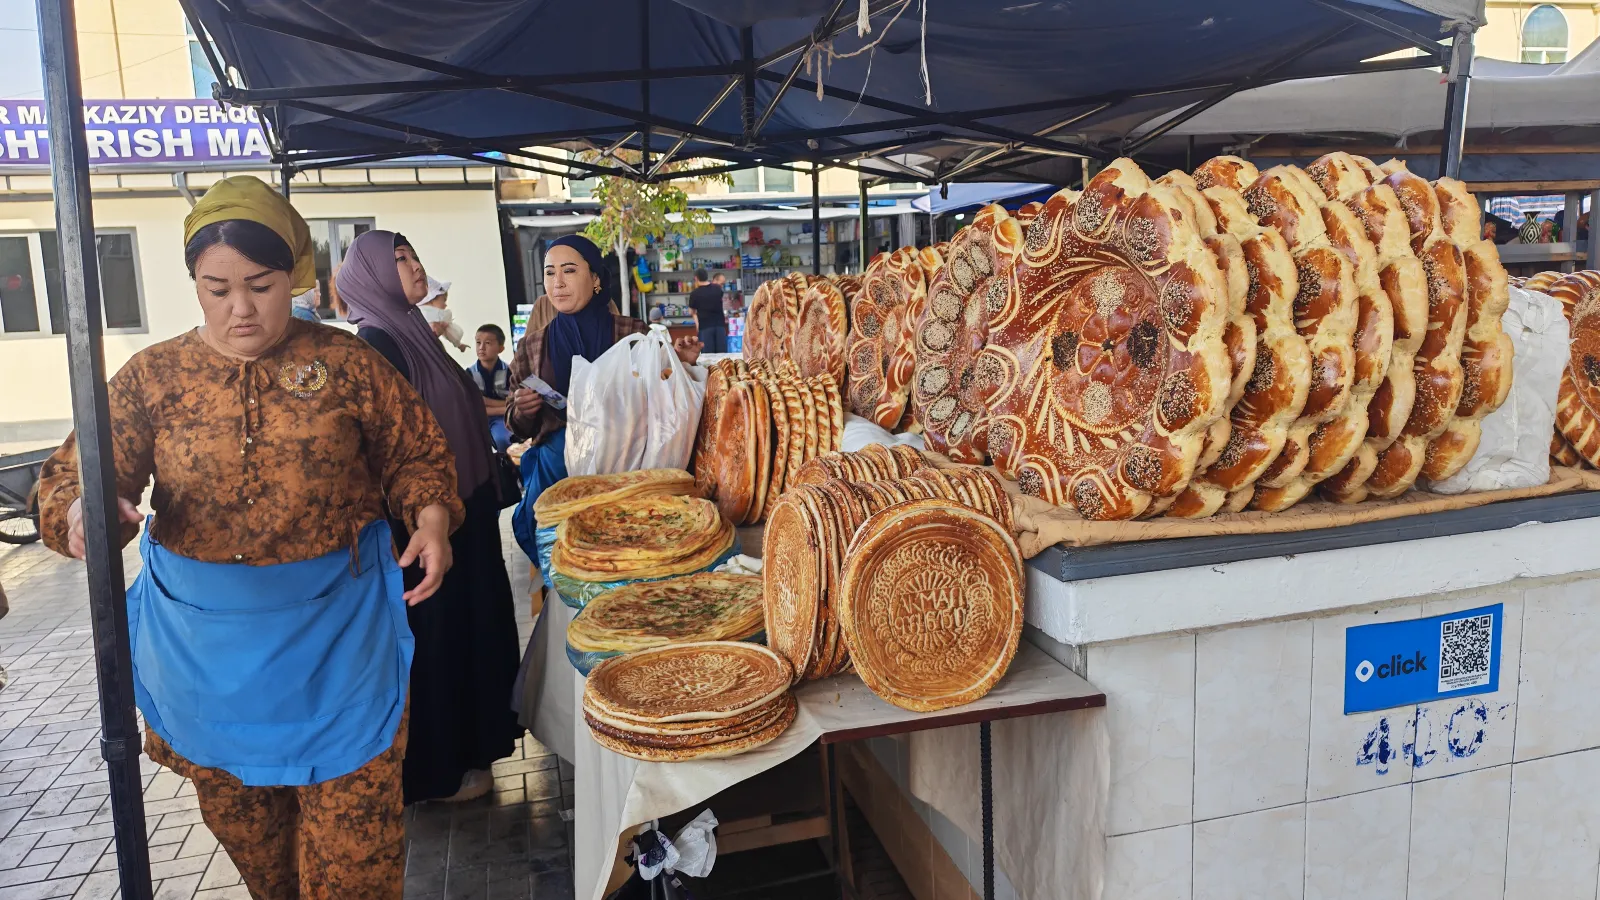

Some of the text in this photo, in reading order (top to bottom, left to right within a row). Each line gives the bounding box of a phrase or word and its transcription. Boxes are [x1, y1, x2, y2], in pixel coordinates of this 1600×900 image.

[17, 106, 165, 124] MKAZIY
[175, 106, 268, 125] DEHQO
[1377, 650, 1427, 679] click
